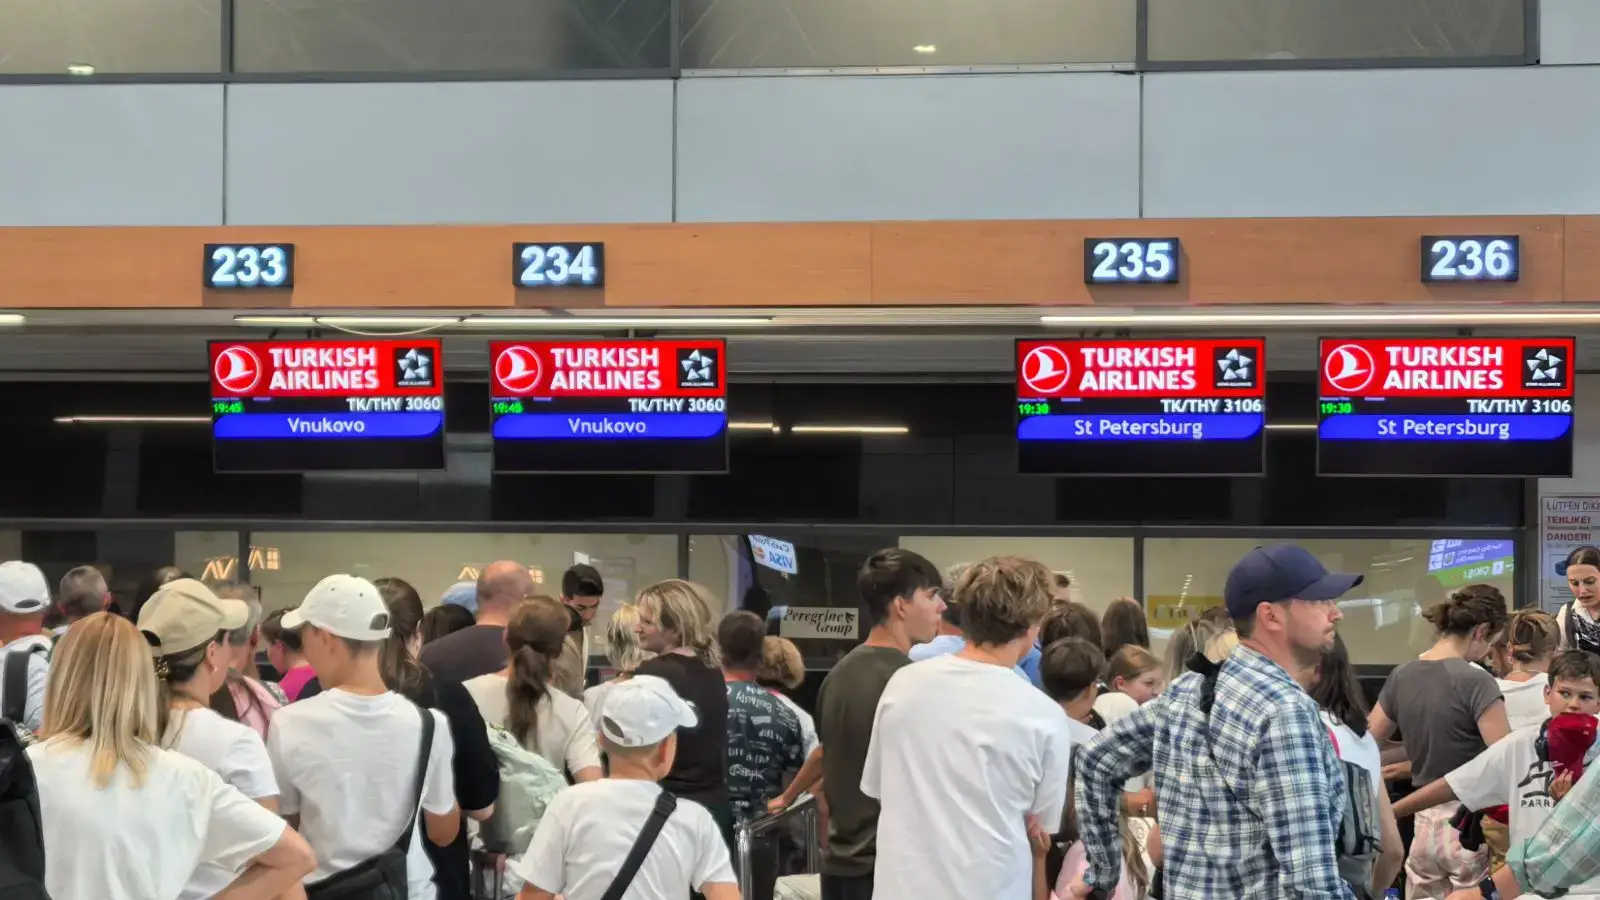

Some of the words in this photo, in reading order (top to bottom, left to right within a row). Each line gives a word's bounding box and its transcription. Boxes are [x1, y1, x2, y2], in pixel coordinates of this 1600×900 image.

[212, 247, 286, 283] 233
[520, 246, 597, 282] 234
[1092, 242, 1172, 279] 235
[1430, 240, 1512, 277] 236
[269, 347, 378, 368] TURKISH
[550, 347, 660, 368] TURKISH
[1080, 347, 1196, 368] TURKISH
[1385, 346, 1503, 367] TURKISH
[269, 369, 379, 390] AIRLINES
[550, 369, 661, 390] AIRLINES
[1079, 369, 1196, 391] AIRLINES
[1383, 369, 1503, 390] AIRLINES
[213, 402, 243, 413] 19:45
[346, 397, 402, 412] TK/THY
[405, 397, 441, 412] 3060
[628, 398, 684, 412] TK/THY
[688, 398, 725, 412] 3060
[1018, 403, 1050, 414] 19:30
[1160, 399, 1219, 413] TK/THY
[1223, 399, 1262, 413] 3106
[1320, 403, 1352, 414] 19:30
[1466, 399, 1527, 413] TK/THY
[1532, 399, 1571, 413] 3106
[287, 417, 365, 433] Vnukovo
[568, 417, 646, 433] Vnukovo
[1074, 419, 1092, 436] St
[1100, 419, 1203, 439] Petersburg
[1377, 419, 1397, 436] St
[1403, 419, 1510, 439] Petersburg
[784, 608, 844, 624] Peregrine
[816, 622, 853, 636] Group
[1521, 799, 1551, 808] PARR
